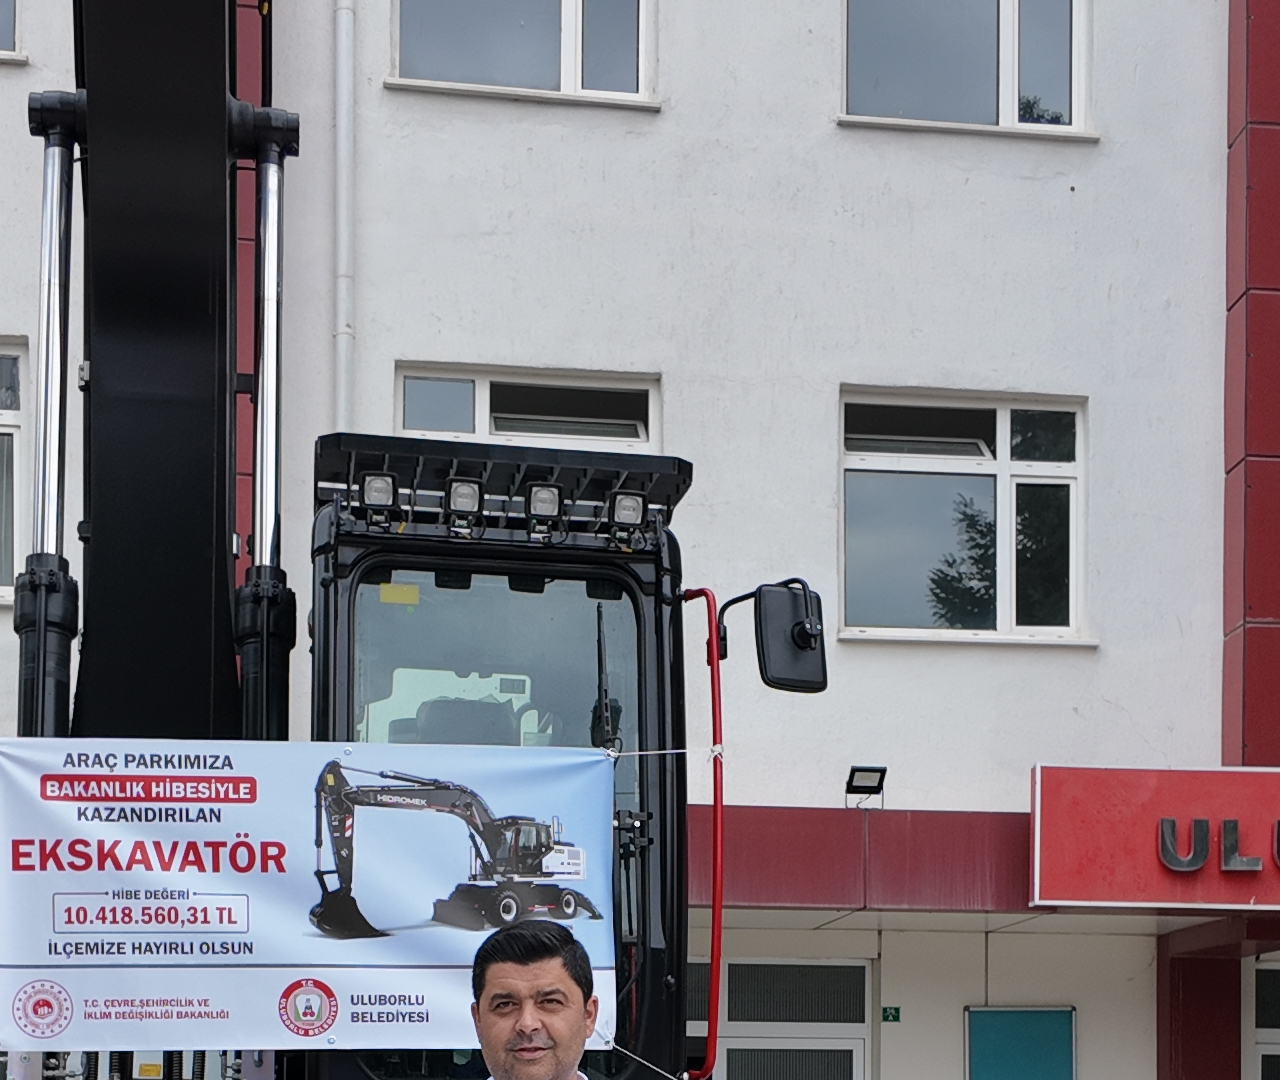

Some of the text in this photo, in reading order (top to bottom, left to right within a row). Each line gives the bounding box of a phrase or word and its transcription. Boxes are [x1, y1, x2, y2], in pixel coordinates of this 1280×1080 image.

[62, 752, 234, 773] ARAÇ PARKIMIZA
[45, 778, 252, 800] BAKANLIK HİBESİYLE
[76, 806, 222, 823] KAZANDIRILAN
[11, 832, 287, 874] EKSKAVATÖR
[111, 887, 190, 901] HİBE DEĞERİ
[63, 905, 238, 929] 10.418.560,31 TL
[47, 938, 254, 960] İLÇEMİZE HAYIRLI OLSUN
[197, 998, 210, 1008] VE
[350, 994, 425, 1007] ULUBORLU
[176, 1008, 230, 1020] BAKANLIĞI
[350, 1008, 430, 1024] BELEDİYESİ
